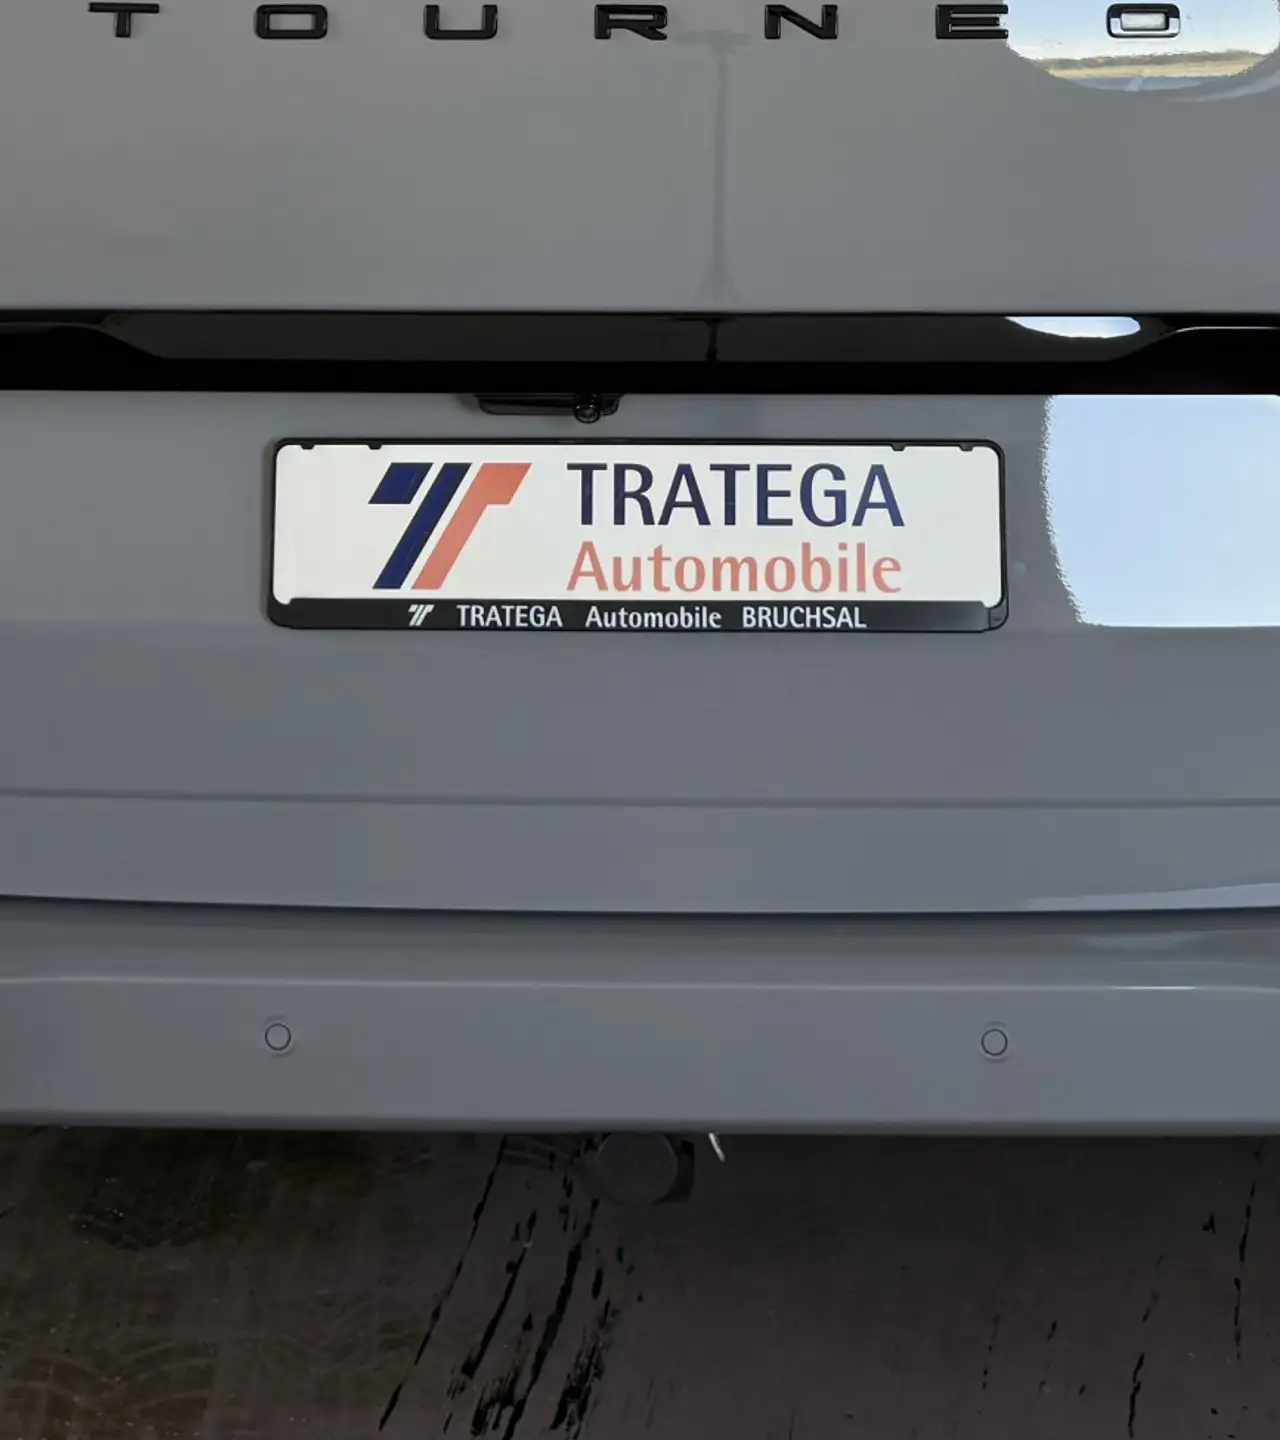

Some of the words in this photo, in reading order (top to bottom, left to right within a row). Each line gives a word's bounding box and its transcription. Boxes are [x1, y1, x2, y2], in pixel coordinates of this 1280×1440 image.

[88, 2, 1182, 40] TOURNEO
[566, 462, 905, 528] TRATEGA
[567, 541, 902, 593] Automobile
[456, 604, 563, 628] TRATEGA
[585, 604, 722, 629] Automobile
[742, 604, 867, 629] BRUCHSAL
